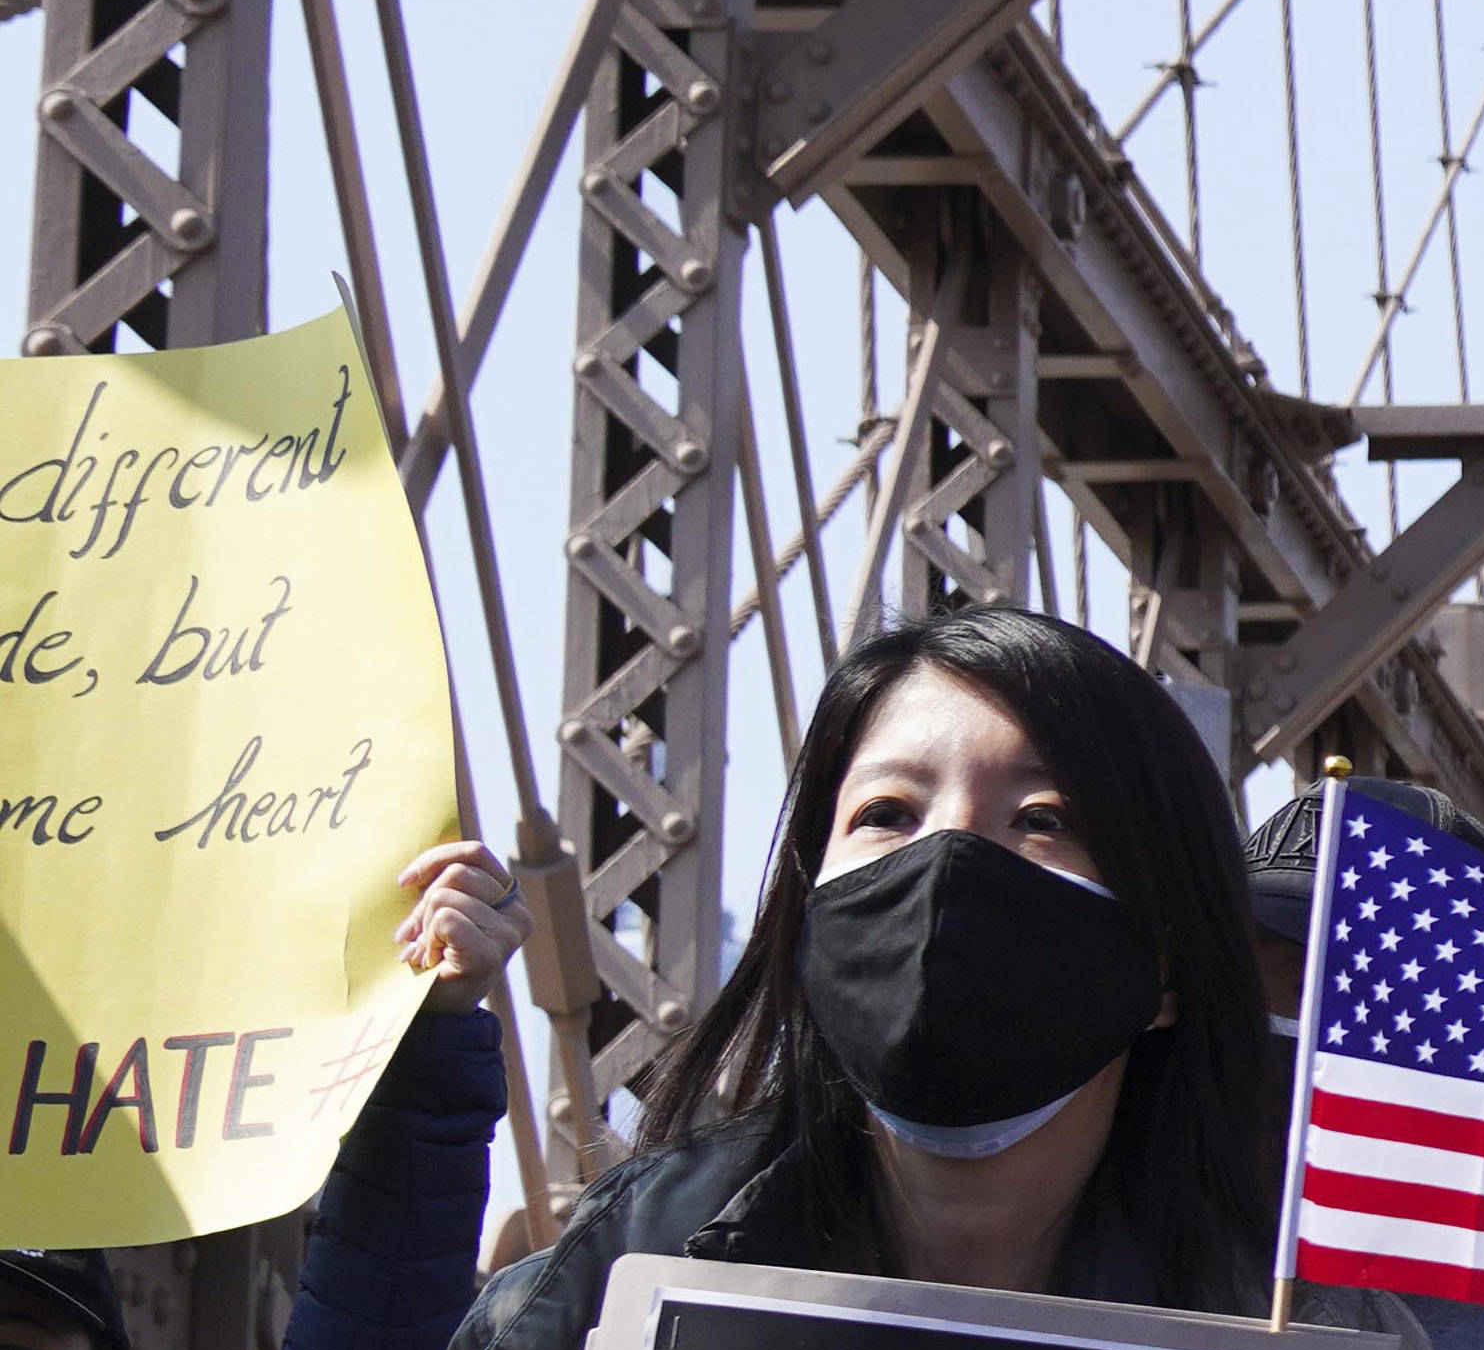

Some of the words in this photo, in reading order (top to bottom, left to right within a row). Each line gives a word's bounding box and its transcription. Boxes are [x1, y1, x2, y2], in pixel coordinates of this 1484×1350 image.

[0, 364, 354, 560] different
[134, 575, 294, 688] but
[155, 734, 373, 851] heart
[8, 1027, 294, 1157] HATE
